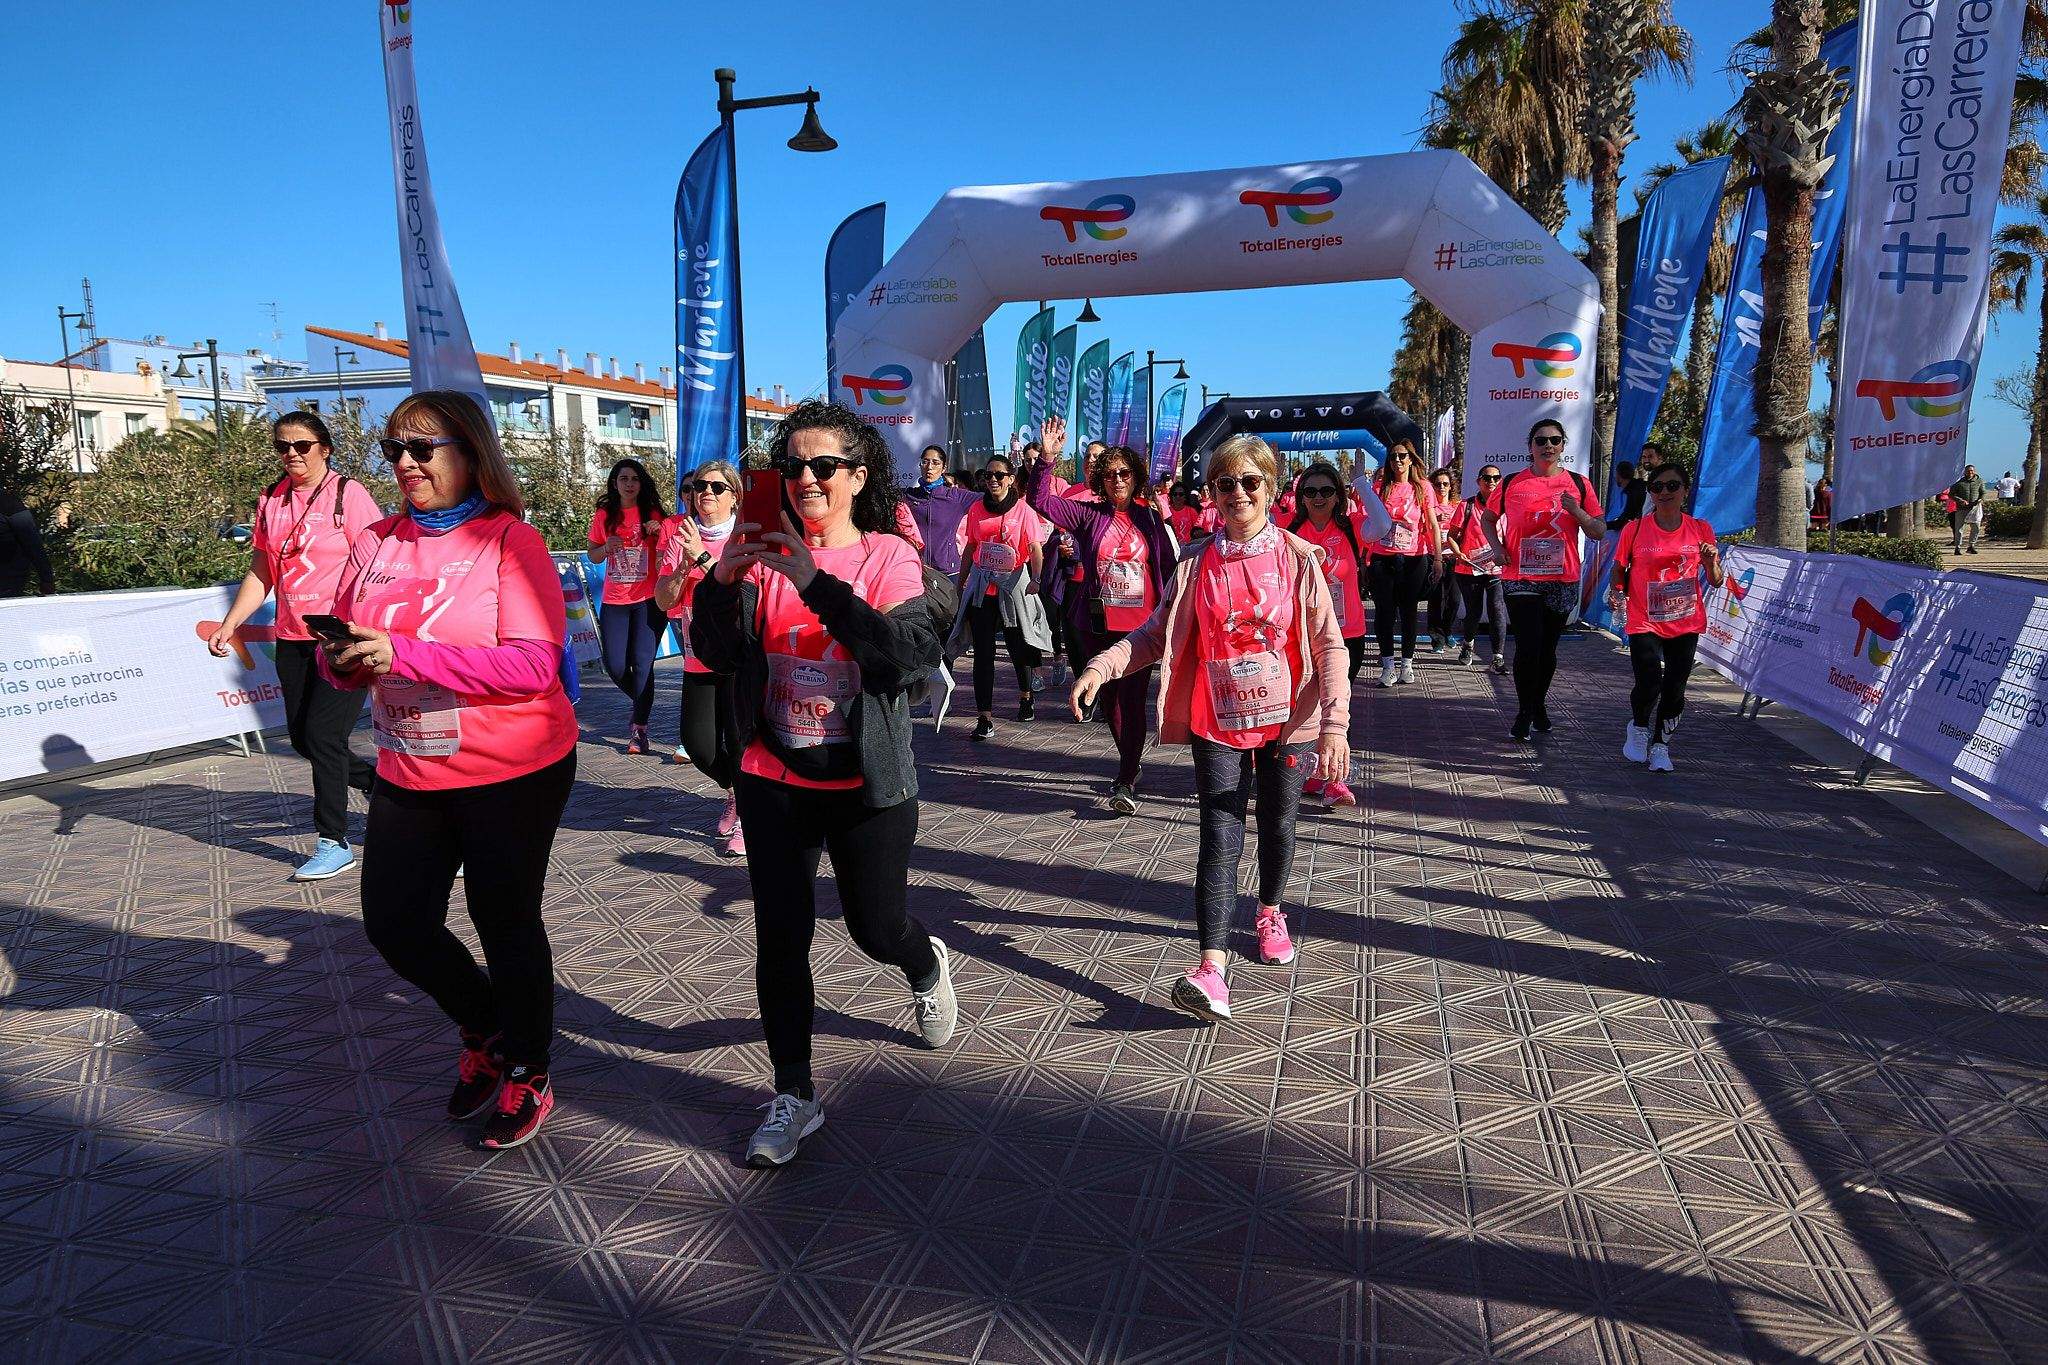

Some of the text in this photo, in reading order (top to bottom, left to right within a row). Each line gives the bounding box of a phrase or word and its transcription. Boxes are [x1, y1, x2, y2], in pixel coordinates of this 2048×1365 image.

[1240, 234, 1343, 253] TotalEnergies
[1041, 250, 1138, 267] TotalEnergies
[677, 240, 736, 392] Marlene
[1624, 257, 1690, 394] Marlene
[1488, 387, 1579, 402] TotalEnergies
[1244, 405, 1354, 420] VOLVO
[1850, 426, 1961, 451] TotalEnergie
[1111, 581, 1130, 590] 016
[13, 651, 93, 670] compañía
[36, 677, 66, 692] que
[71, 667, 144, 688] patrocina
[1827, 666, 1885, 704] TotalEnergies
[36, 691, 118, 714] preferidas
[1237, 686, 1268, 701] 016
[386, 704, 422, 720] 016
[791, 700, 828, 718] 016
[421, 731, 446, 739] VALENCIA
[416, 743, 450, 751] Santander
